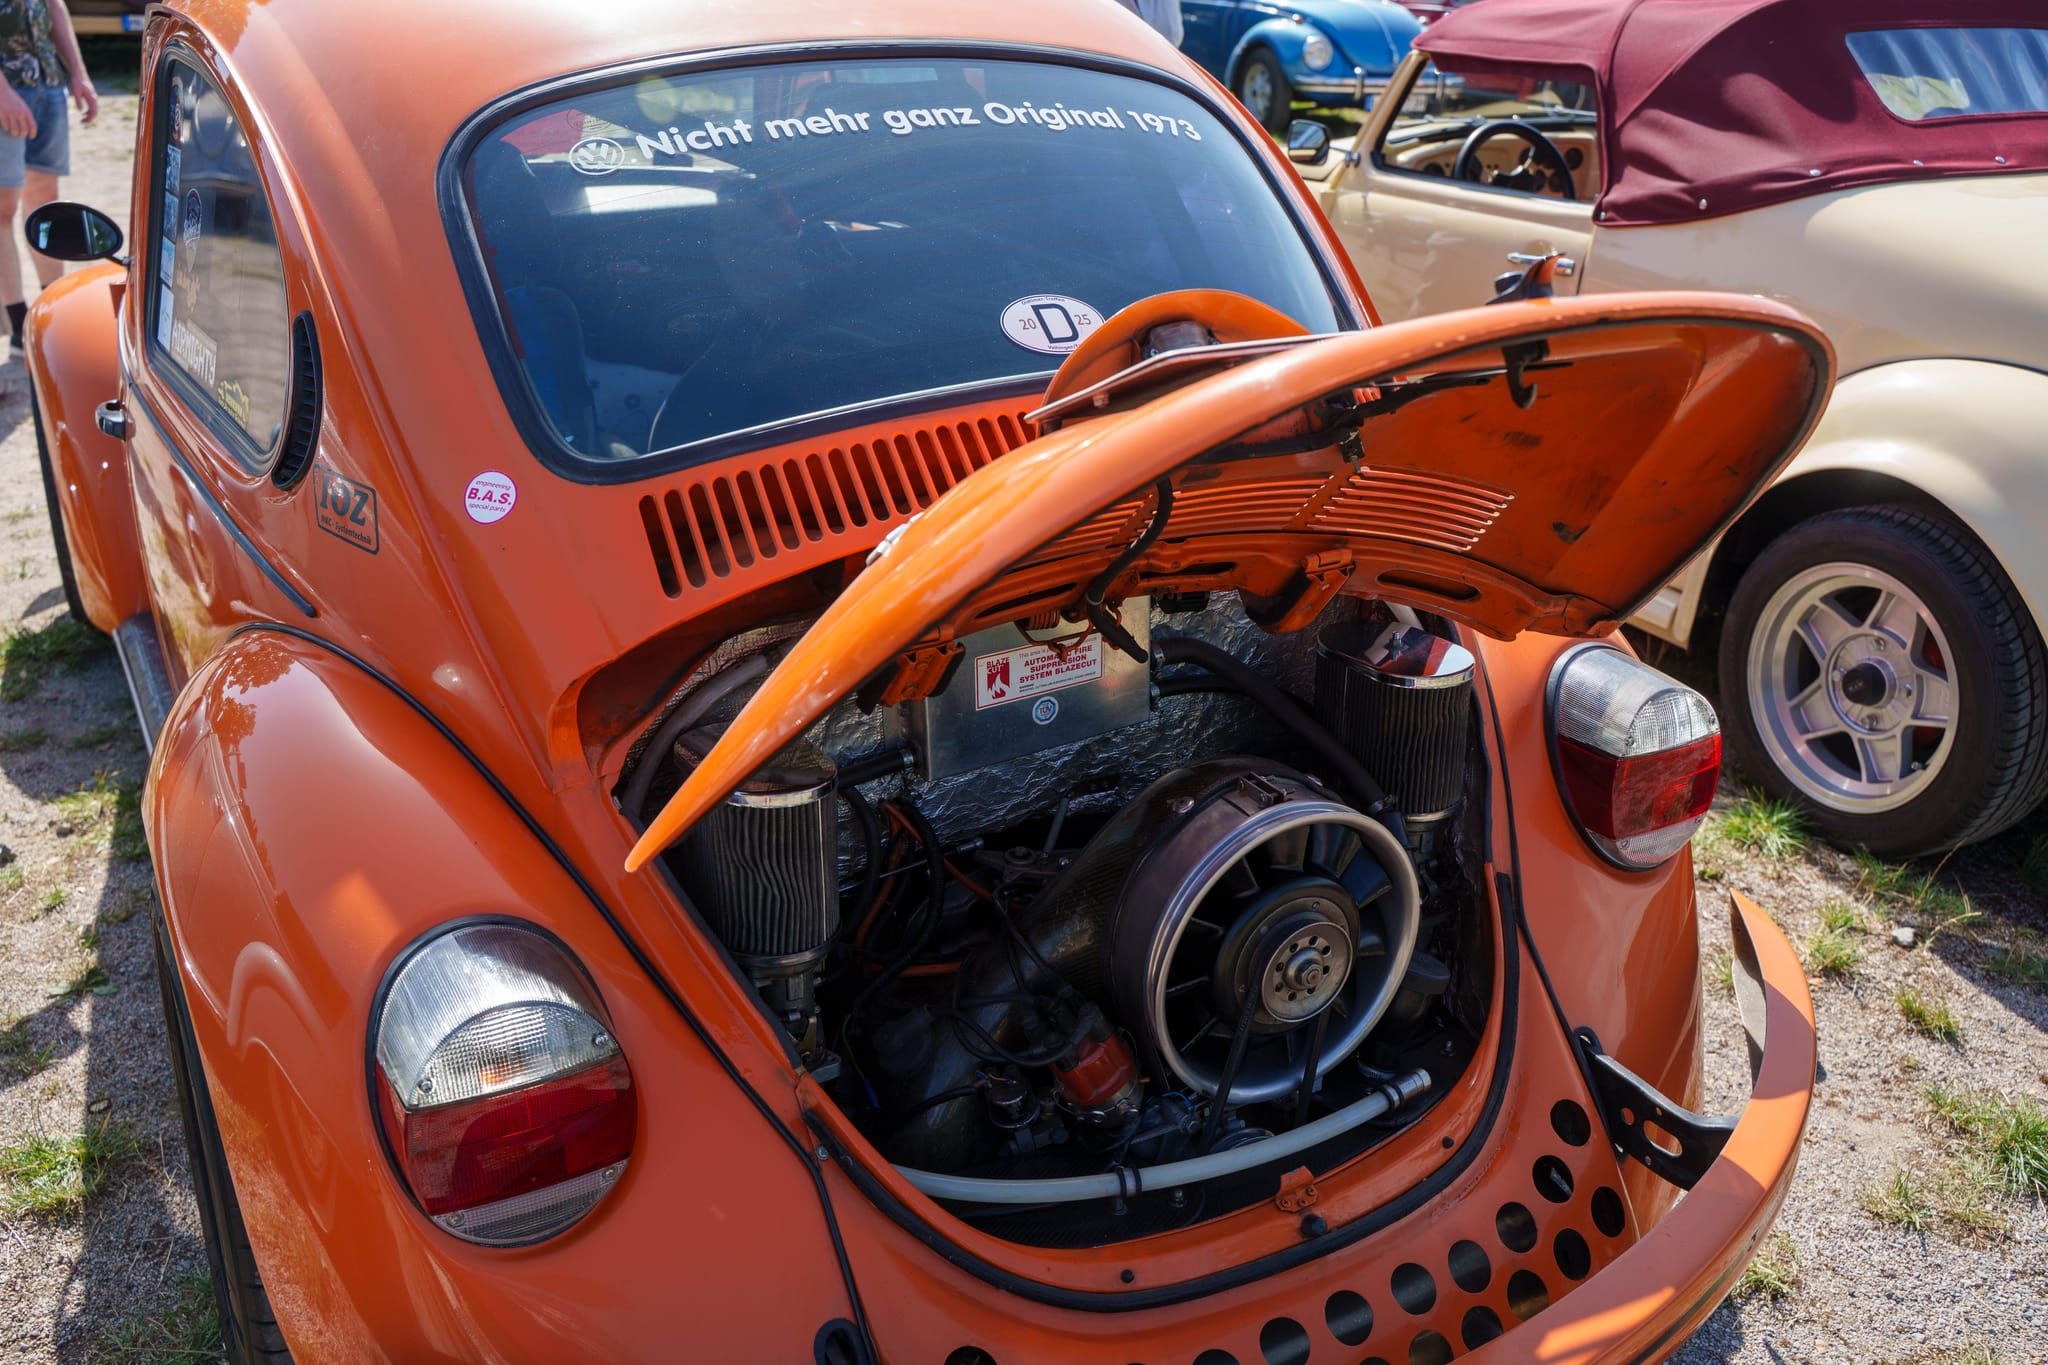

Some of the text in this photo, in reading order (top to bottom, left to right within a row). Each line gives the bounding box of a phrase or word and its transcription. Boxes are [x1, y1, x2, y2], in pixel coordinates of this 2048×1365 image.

[636, 119, 753, 160] Nicht
[765, 108, 871, 140] mehr
[883, 108, 981, 135] ganz
[982, 102, 1125, 132] Original
[1128, 110, 1202, 141] 1973
[1019, 303, 1092, 344] 20 D 25
[467, 487, 512, 506] B.A.S.
[1024, 644, 1093, 667] AUTOMAC FIRE
[1030, 654, 1087, 673] SUPPRESSION
[1019, 670, 1052, 684] SYSTEM
[1055, 659, 1097, 675] BLAZECUT
